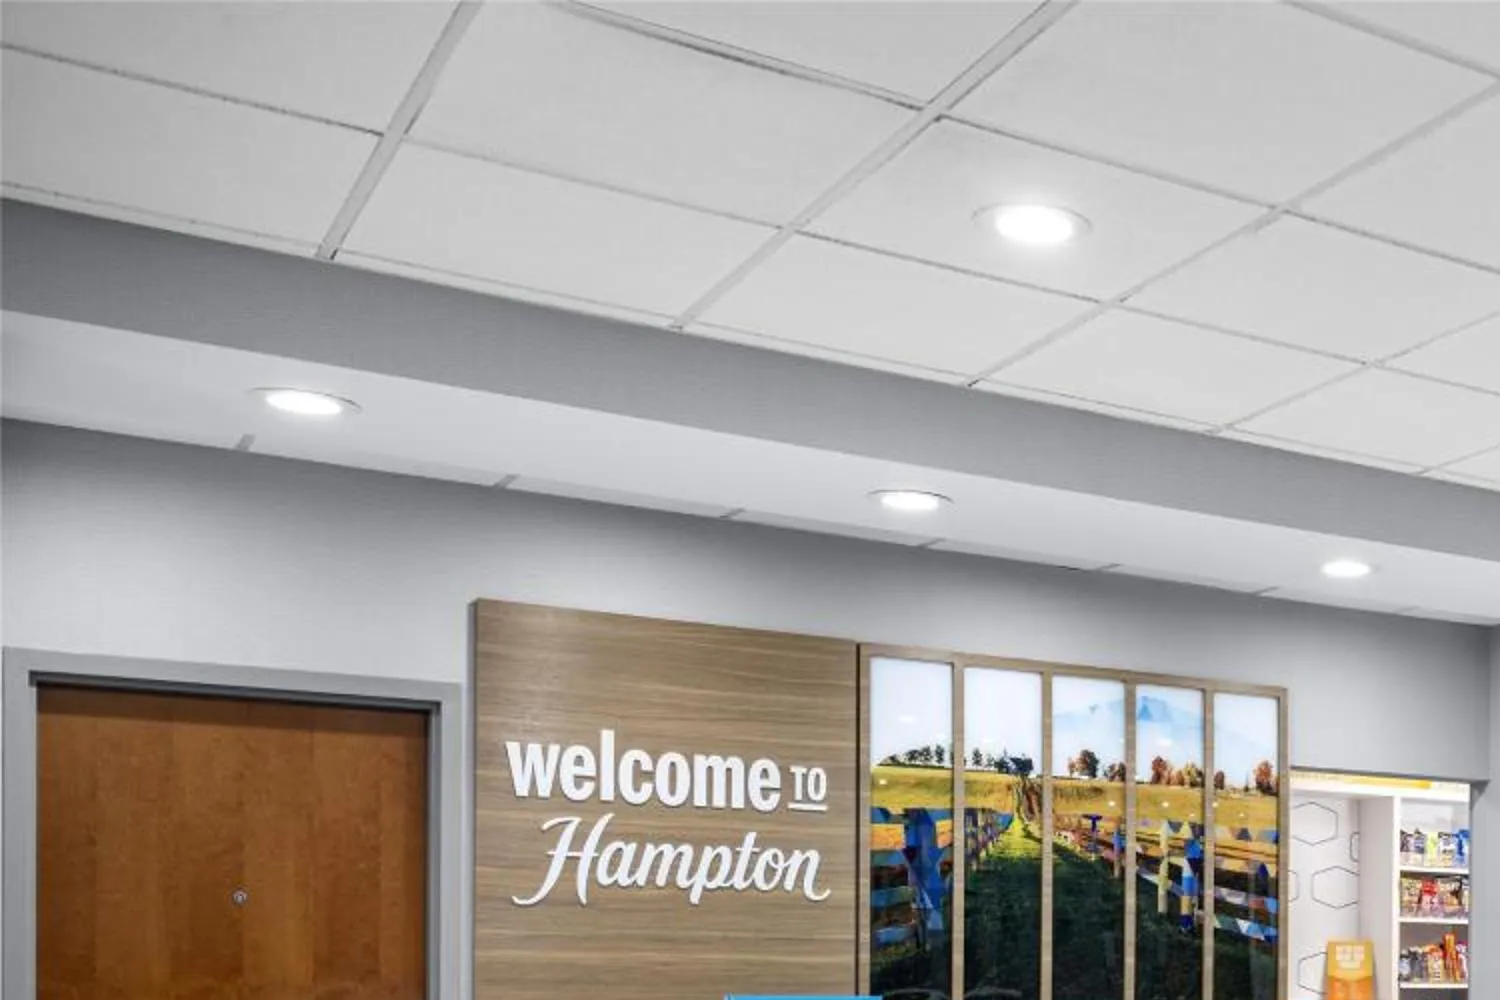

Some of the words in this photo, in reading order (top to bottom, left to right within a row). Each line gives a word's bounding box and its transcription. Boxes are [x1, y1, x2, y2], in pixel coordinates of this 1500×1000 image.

[505, 729, 781, 812] welcome
[789, 764, 828, 803] TO
[511, 812, 831, 905] Hampton
